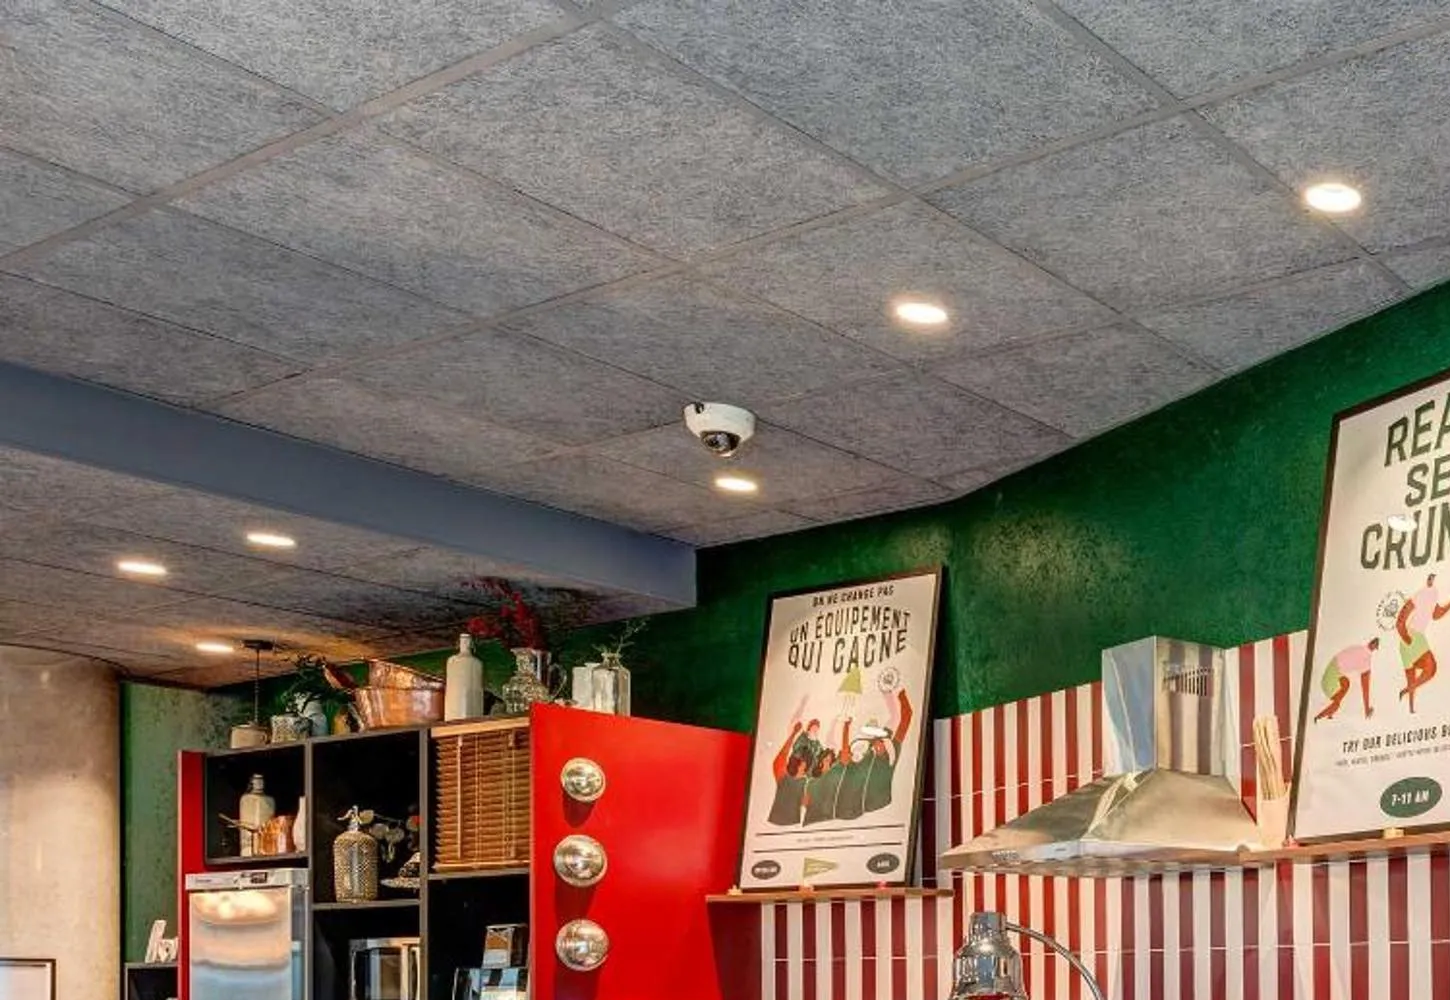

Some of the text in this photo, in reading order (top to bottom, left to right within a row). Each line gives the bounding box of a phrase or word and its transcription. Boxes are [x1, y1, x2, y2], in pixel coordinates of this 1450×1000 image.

[877, 585, 894, 598] PAS
[790, 621, 809, 644] UN
[788, 641, 823, 673] QUI
[1342, 739, 1360, 753] TRY
[1363, 735, 1381, 750] OUR
[1385, 726, 1437, 747] DELICIOUS
[1391, 790, 1430, 807] 7-11 AM
